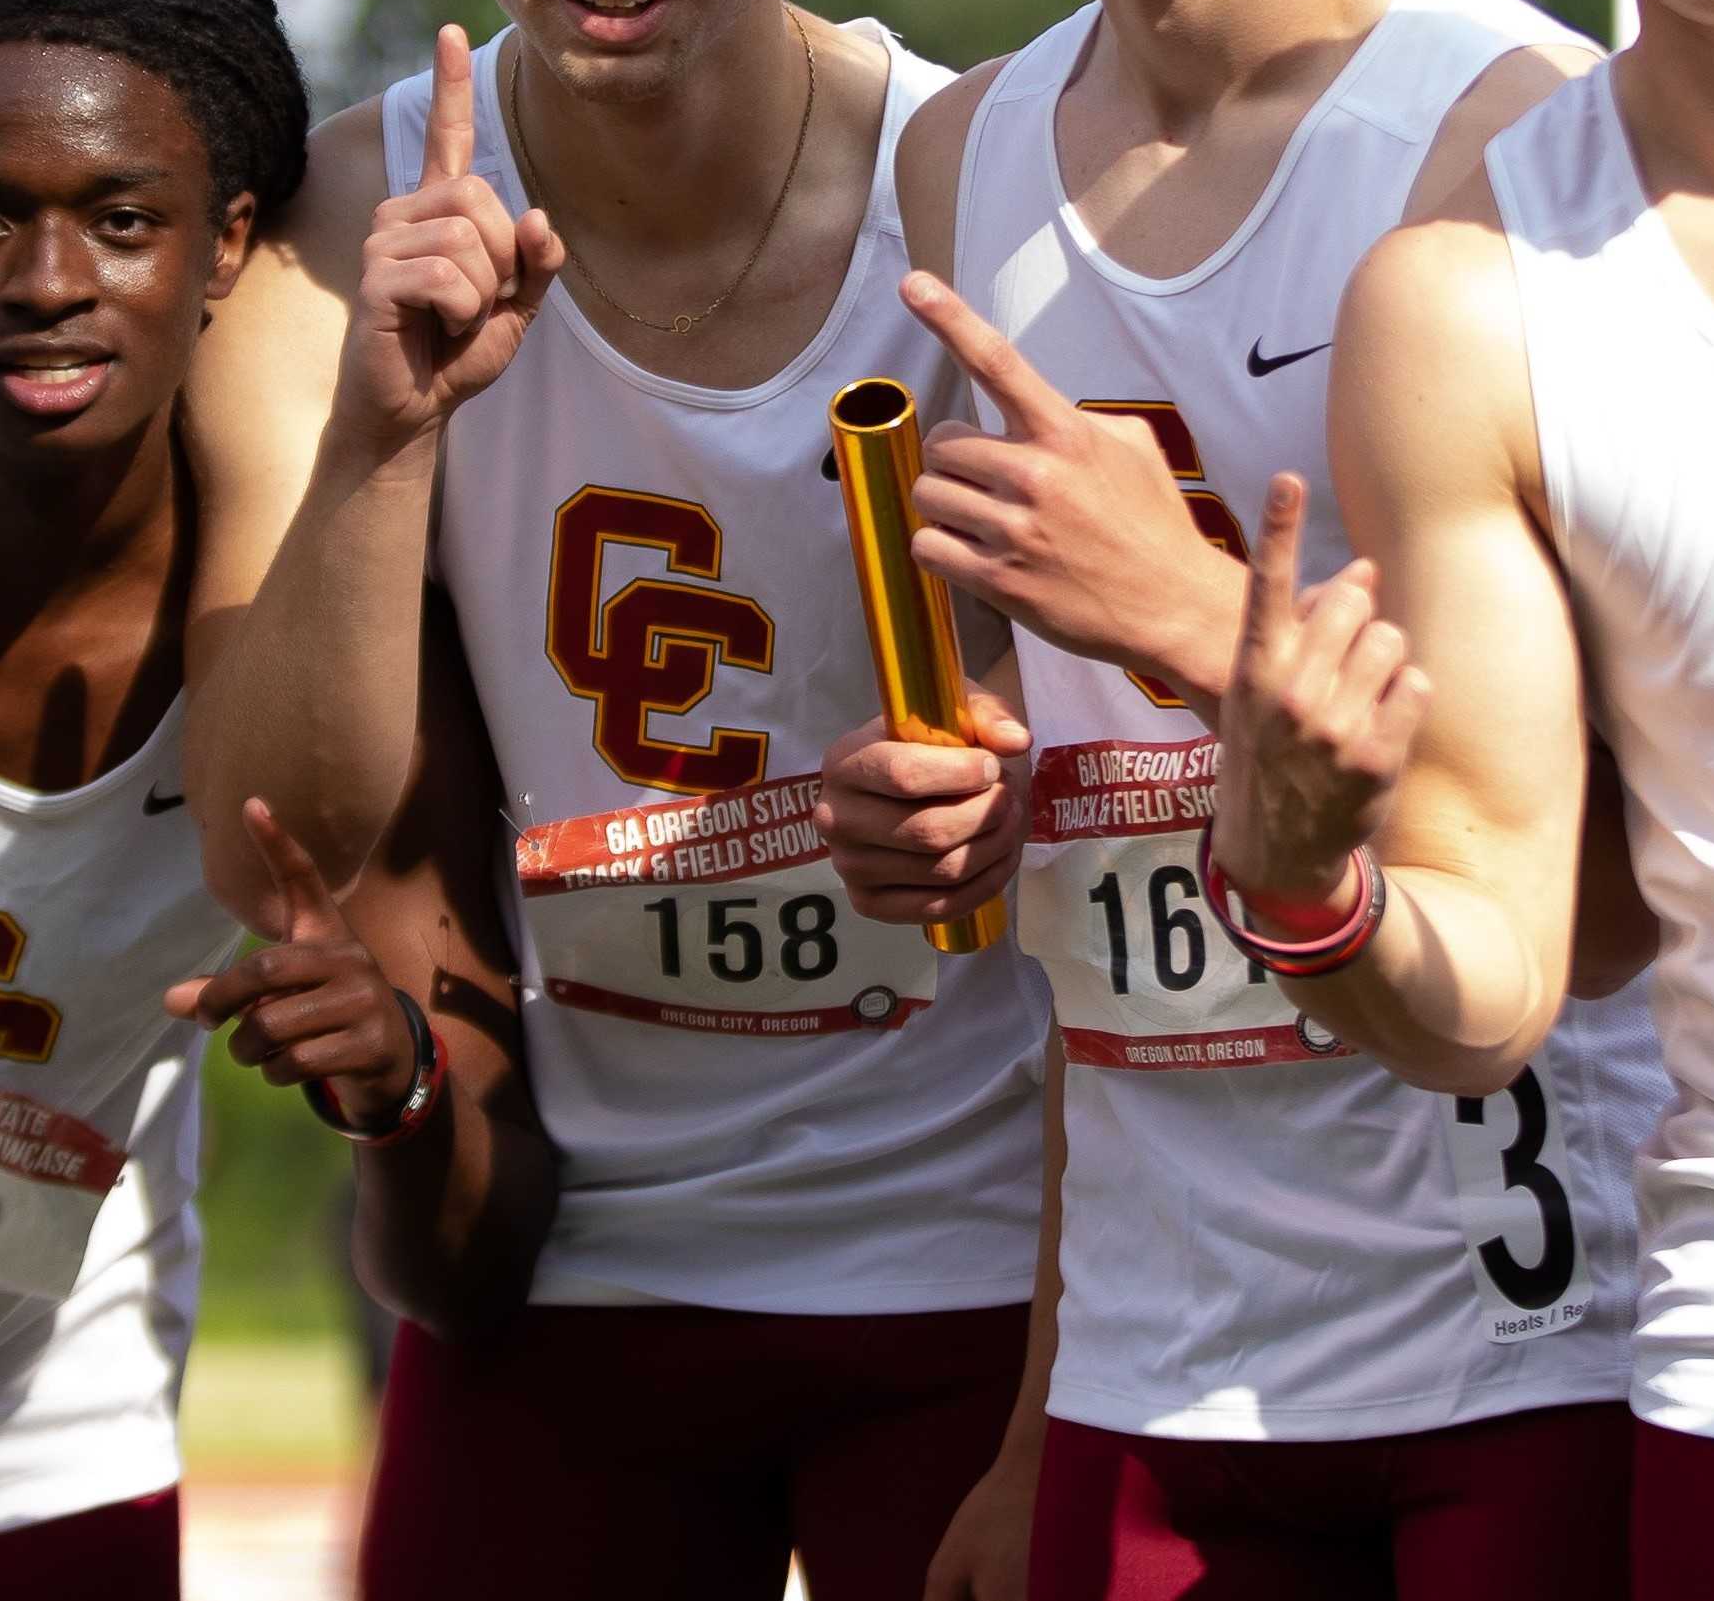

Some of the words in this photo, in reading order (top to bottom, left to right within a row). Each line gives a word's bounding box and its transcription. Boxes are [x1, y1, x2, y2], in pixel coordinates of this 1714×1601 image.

[544, 483, 775, 797] CC
[1077, 752, 1101, 787] 6A
[1100, 751, 1186, 784] OREGON
[605, 818, 644, 855] 6A
[646, 797, 749, 847] OREGON
[752, 780, 822, 825] STATE
[1052, 794, 1100, 832] TRACK
[1099, 793, 1110, 825] &
[1112, 789, 1174, 824] FIELD
[559, 856, 645, 889] TRACK
[650, 853, 669, 881] &
[674, 838, 744, 880] FIELD
[748, 820, 827, 865] SHOW
[643, 893, 839, 984] 158
[660, 1009, 716, 1028] OREGON
[721, 1017, 756, 1032] CITY,
[762, 1017, 819, 1031] OREGON
[1125, 1046, 1174, 1064] OREGON
[1207, 1038, 1266, 1061] OREGON
[1454, 1063, 1575, 1311] 3
[1495, 1315, 1543, 1336] Heats
